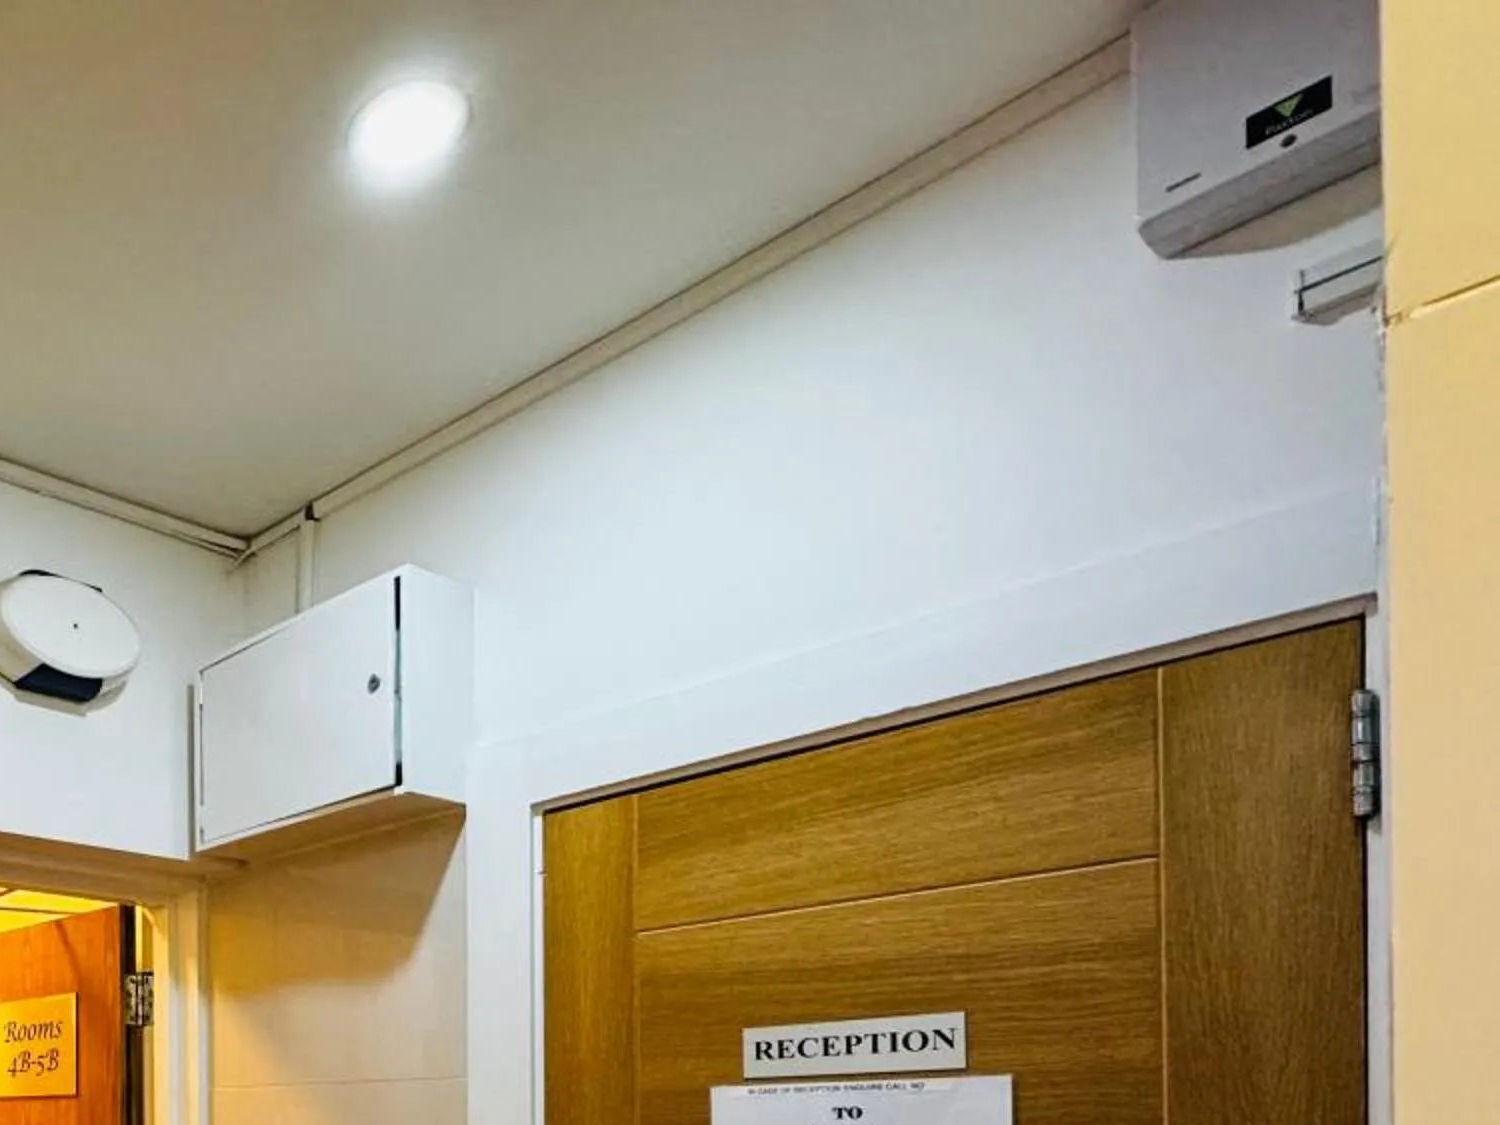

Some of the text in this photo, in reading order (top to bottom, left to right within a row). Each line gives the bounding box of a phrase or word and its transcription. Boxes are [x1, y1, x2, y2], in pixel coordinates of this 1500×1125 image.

[4, 1020, 63, 1043] Rooms
[754, 1027, 956, 1061] RECEPTION
[7, 1048, 60, 1077] 4B-5B
[832, 1106, 863, 1121] TO
